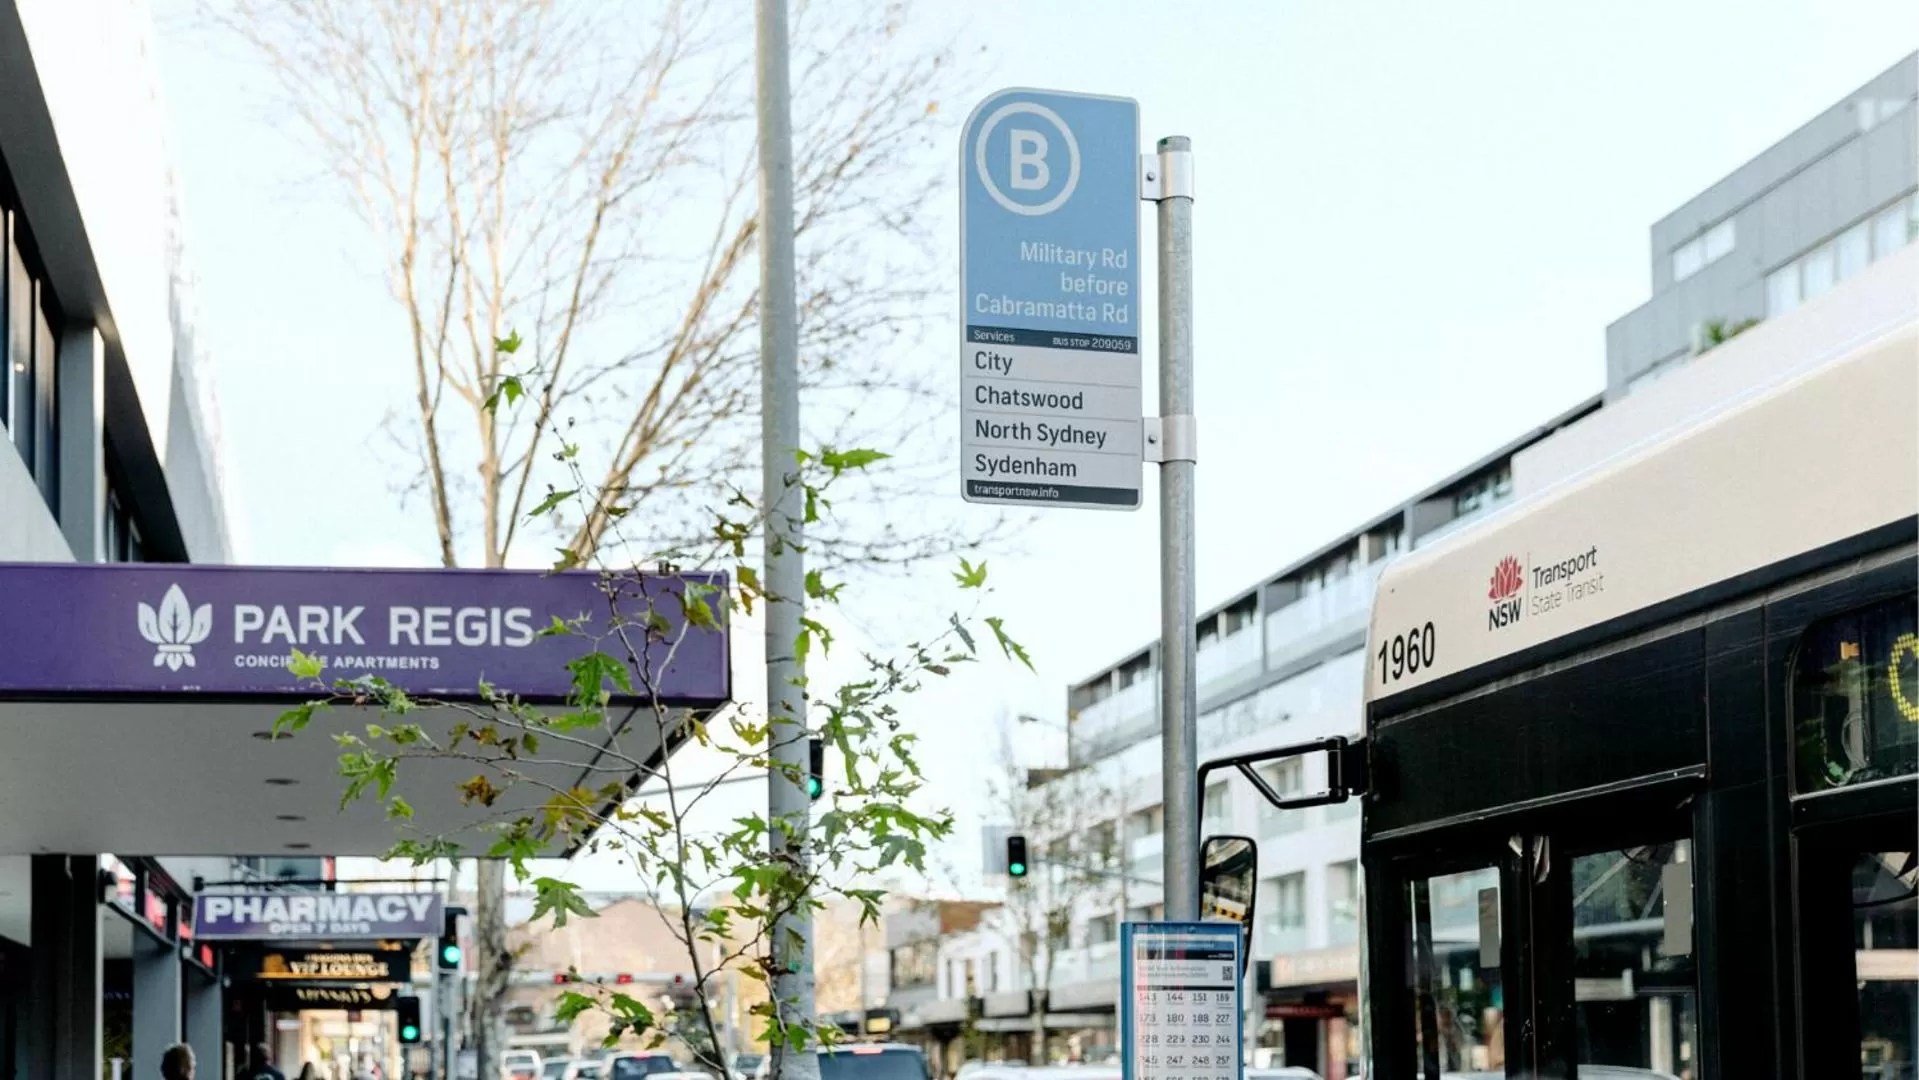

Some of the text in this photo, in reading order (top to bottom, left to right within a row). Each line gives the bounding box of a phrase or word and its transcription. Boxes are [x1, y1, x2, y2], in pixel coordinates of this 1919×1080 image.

[1010, 128, 1050, 190] B
[1020, 240, 1128, 270] Military Rd
[1060, 271, 1128, 296] before
[974, 293, 1128, 324] Cabramatta Rd
[974, 329, 1015, 343] Services
[1052, 336, 1132, 350] BUS STOP 209059
[975, 350, 1013, 375] City
[975, 385, 1083, 410] Chatswood
[975, 419, 1107, 449] North Sydney
[975, 453, 1077, 477] Sydenham
[974, 484, 1059, 498] transportnsw.info
[1532, 545, 1598, 589] Transport
[1531, 574, 1605, 617] State Transit
[234, 604, 533, 647] PARK REGIS
[1488, 597, 1522, 631] NSW
[333, 656, 440, 670] APARTMENTS
[1377, 621, 1436, 685] 1960
[204, 895, 433, 923] PHARMACY
[269, 922, 371, 934] OPEN 7 DAYS
